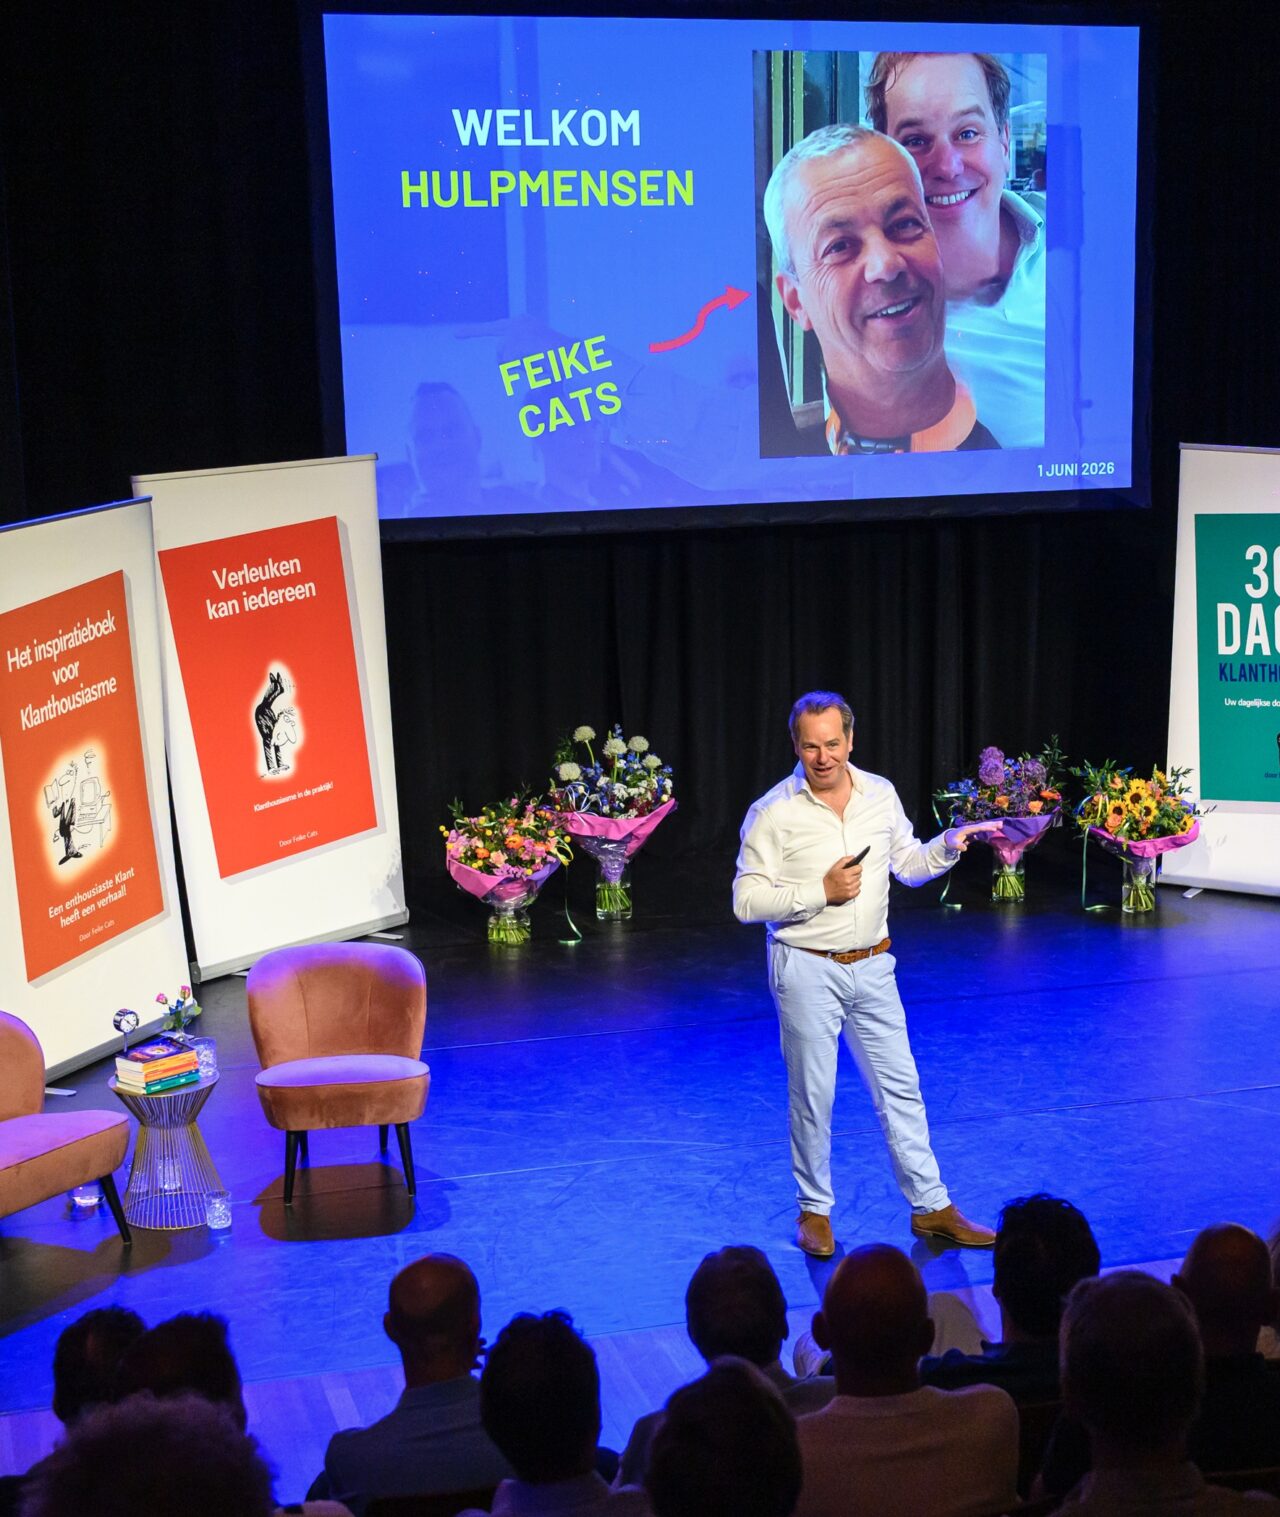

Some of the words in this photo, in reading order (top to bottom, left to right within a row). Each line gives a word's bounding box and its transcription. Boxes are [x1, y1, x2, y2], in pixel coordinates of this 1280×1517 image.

[451, 108, 641, 147] WELKOM
[401, 169, 694, 208] HULPMENSEN
[499, 335, 612, 397] FEIKE
[518, 381, 622, 438] CATS
[1037, 464, 1043, 477] 1
[1045, 463, 1078, 477] JUNI
[1081, 462, 1115, 476] 2026
[212, 557, 302, 590] Verleuken
[206, 598, 240, 620] kan
[242, 582, 317, 612] iedereen
[6, 645, 33, 672] Het
[33, 609, 117, 662] inspiratieboek
[52, 660, 80, 686] voor
[20, 676, 118, 731] Klanthousiasme
[1224, 698, 1237, 706] Uw
[1238, 699, 1271, 708] dagelijkse
[48, 904, 64, 919] Een
[65, 879, 114, 910] enthousiaste
[114, 867, 135, 885] Klant
[81, 903, 96, 917] een
